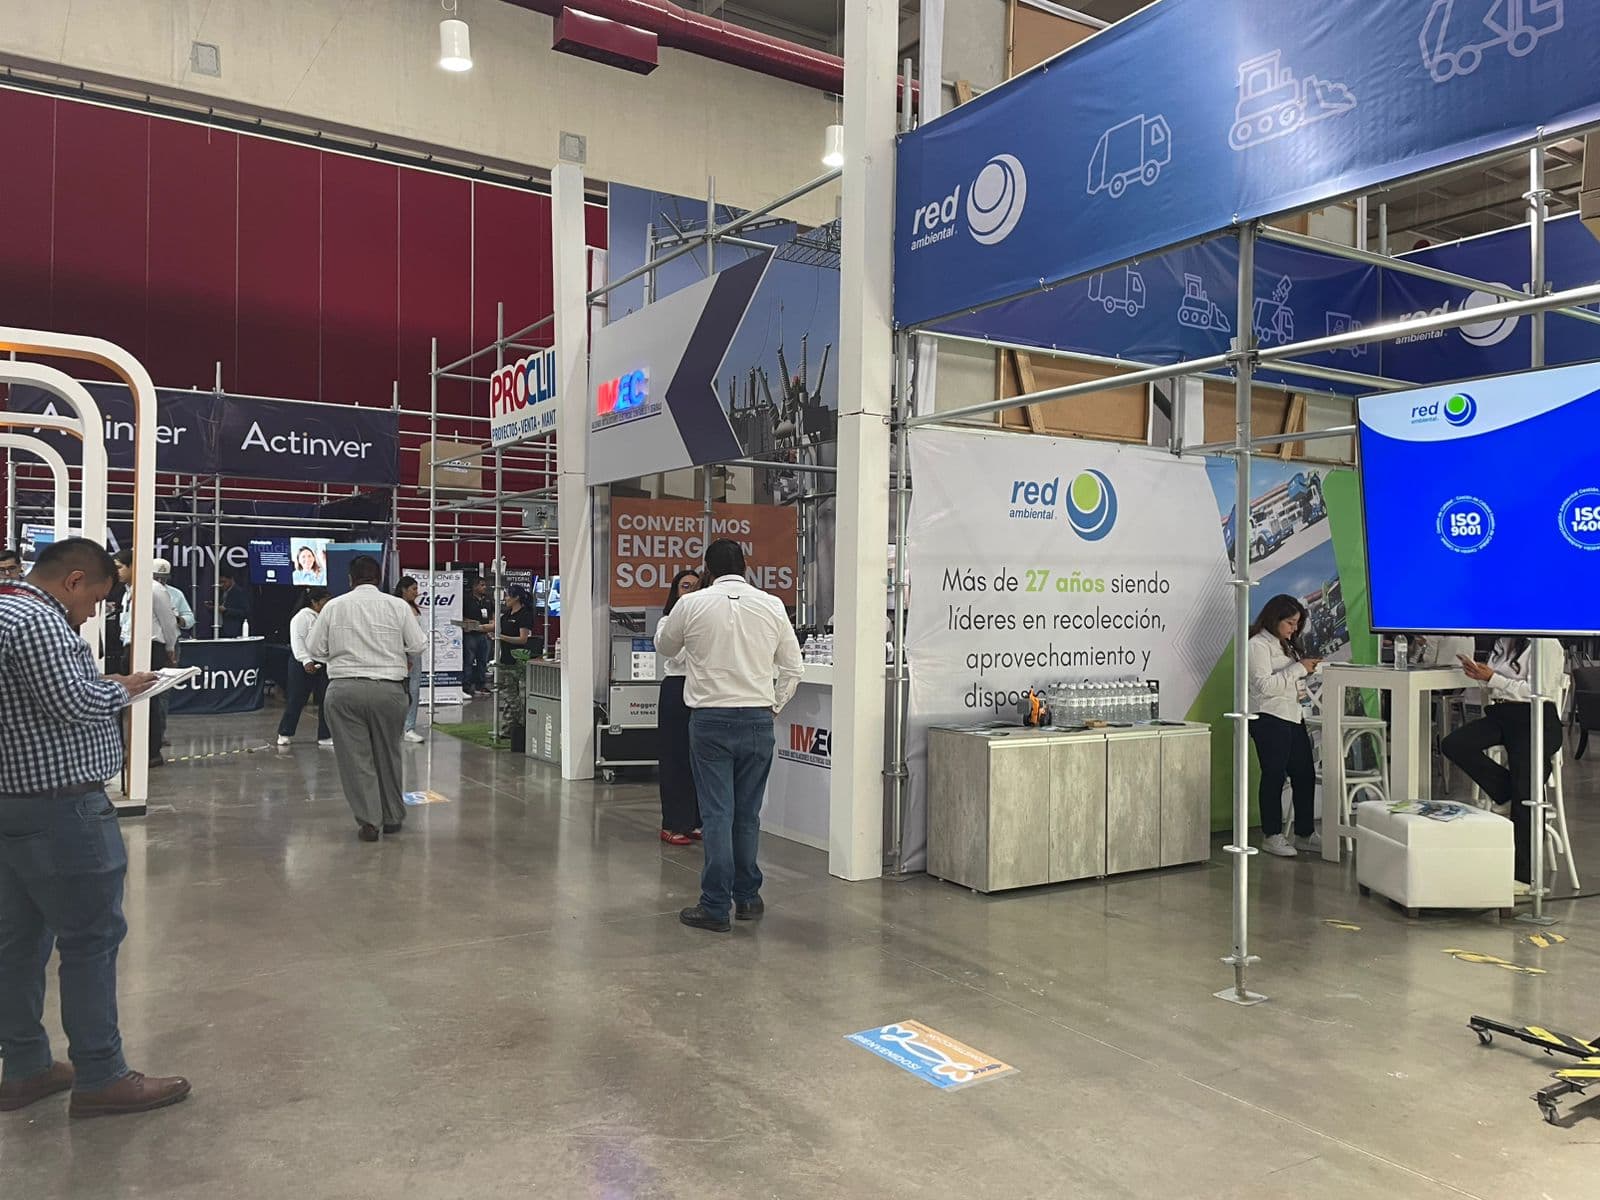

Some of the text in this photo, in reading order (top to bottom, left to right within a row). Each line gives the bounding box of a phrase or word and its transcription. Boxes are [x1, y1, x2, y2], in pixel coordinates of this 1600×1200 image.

[913, 184, 960, 235] red
[911, 224, 955, 251] ambiental
[1395, 330, 1444, 344] ambiental
[1411, 401, 1439, 418] red
[241, 421, 373, 459] Actinver
[1011, 476, 1059, 506] red
[617, 513, 751, 535] CONVERTMOS
[1009, 508, 1054, 520] ambiental
[1451, 512, 1481, 526] ISO
[1450, 525, 1481, 536] 9001
[617, 534, 703, 559] ENERG
[942, 567, 1170, 594] Más de 27 años siendo
[948, 604, 1166, 632] líderes en recolección,
[966, 642, 1151, 677] aprovechamiento y
